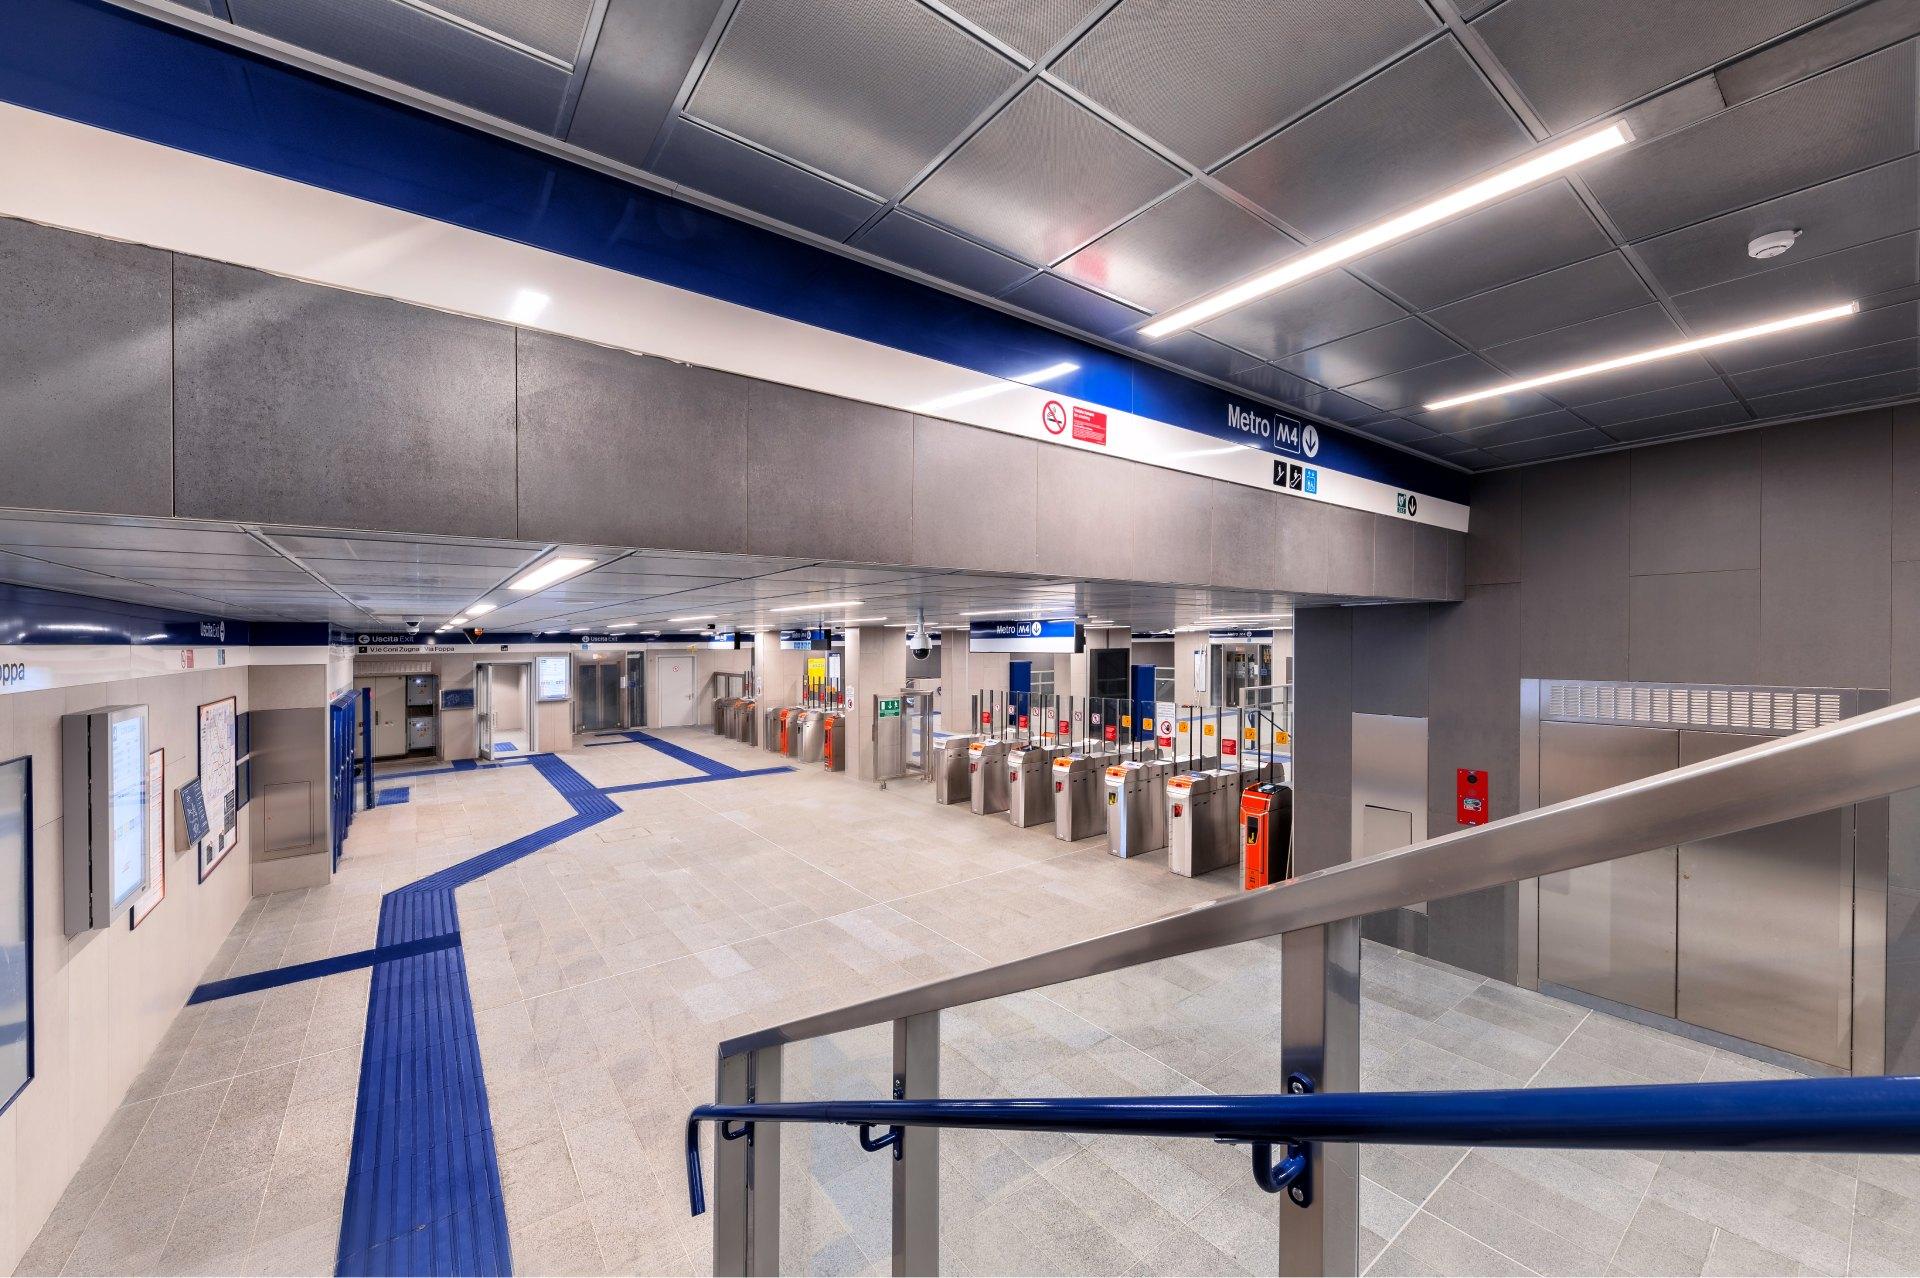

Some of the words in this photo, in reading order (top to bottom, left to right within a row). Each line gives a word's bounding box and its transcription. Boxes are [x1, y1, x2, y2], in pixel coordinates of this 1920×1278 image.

[1228, 403, 1270, 437] Metro
[1277, 422, 1298, 446] M4
[996, 625, 1015, 634] Metro
[1018, 626, 1030, 634] M4
[372, 635, 399, 643] Uscita
[0, 662, 25, 686] ppa
